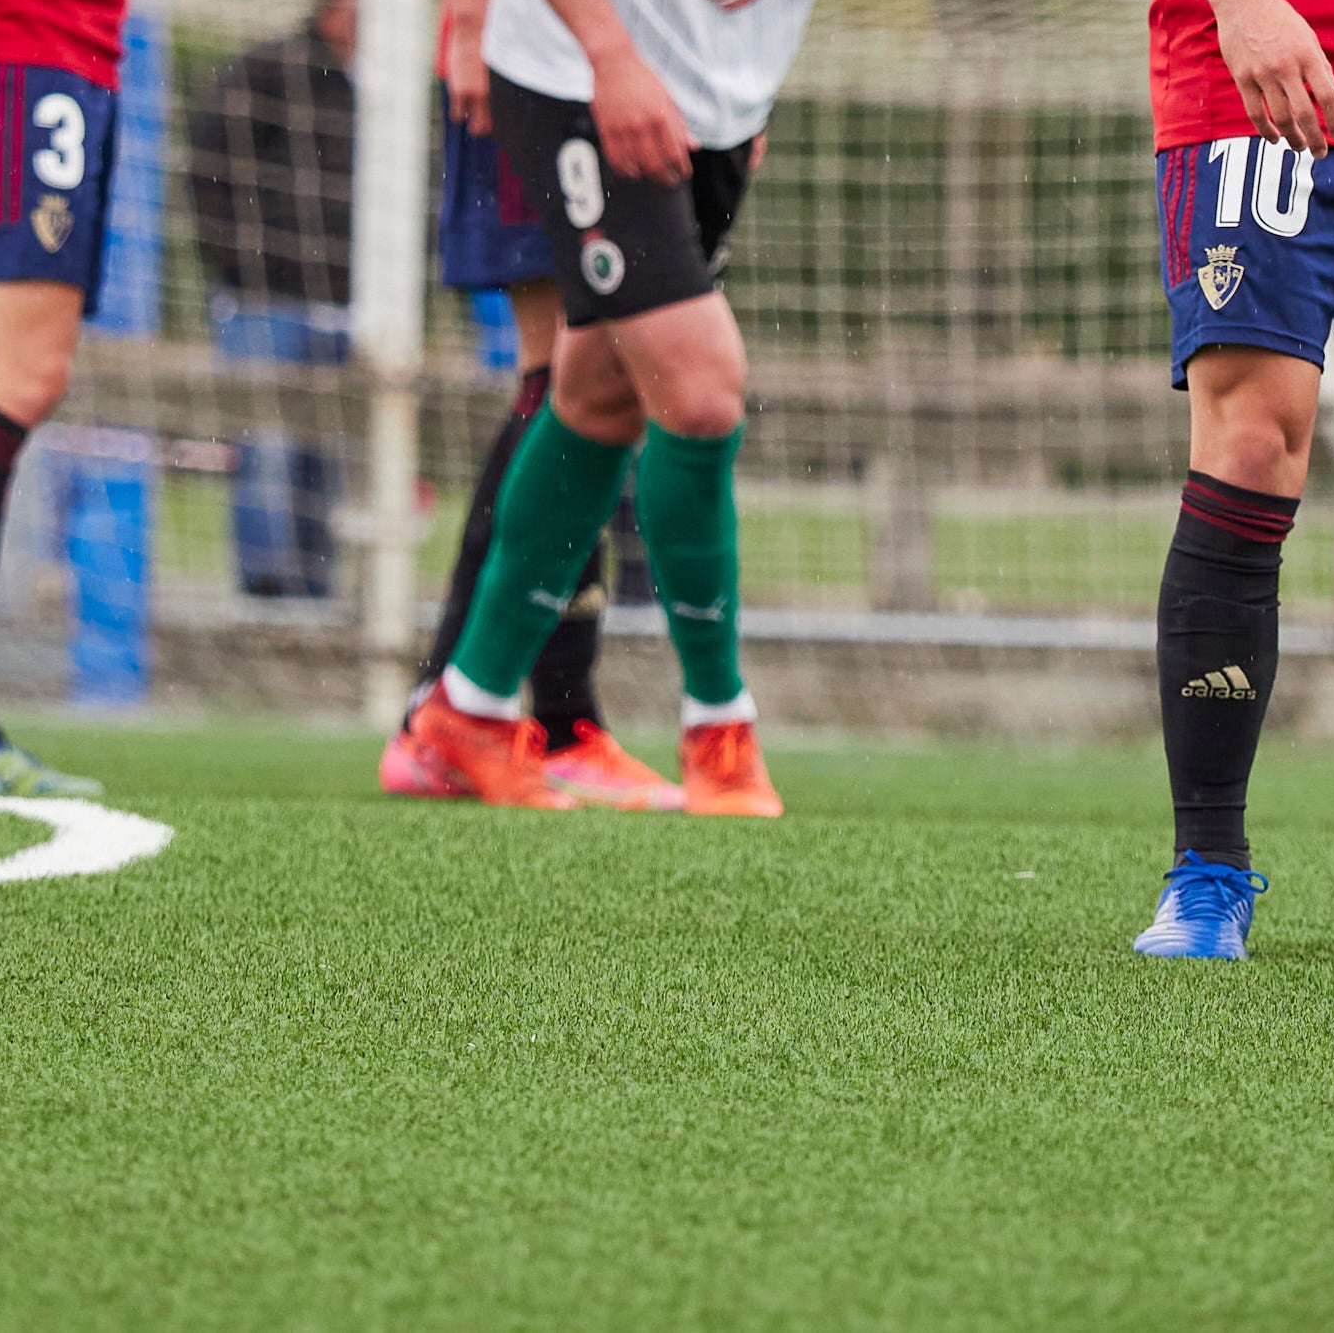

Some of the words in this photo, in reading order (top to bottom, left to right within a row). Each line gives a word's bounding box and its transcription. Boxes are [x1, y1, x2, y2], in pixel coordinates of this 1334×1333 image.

[32, 93, 86, 190] 3
[556, 137, 606, 229] 9
[1208, 135, 1315, 237] 10
